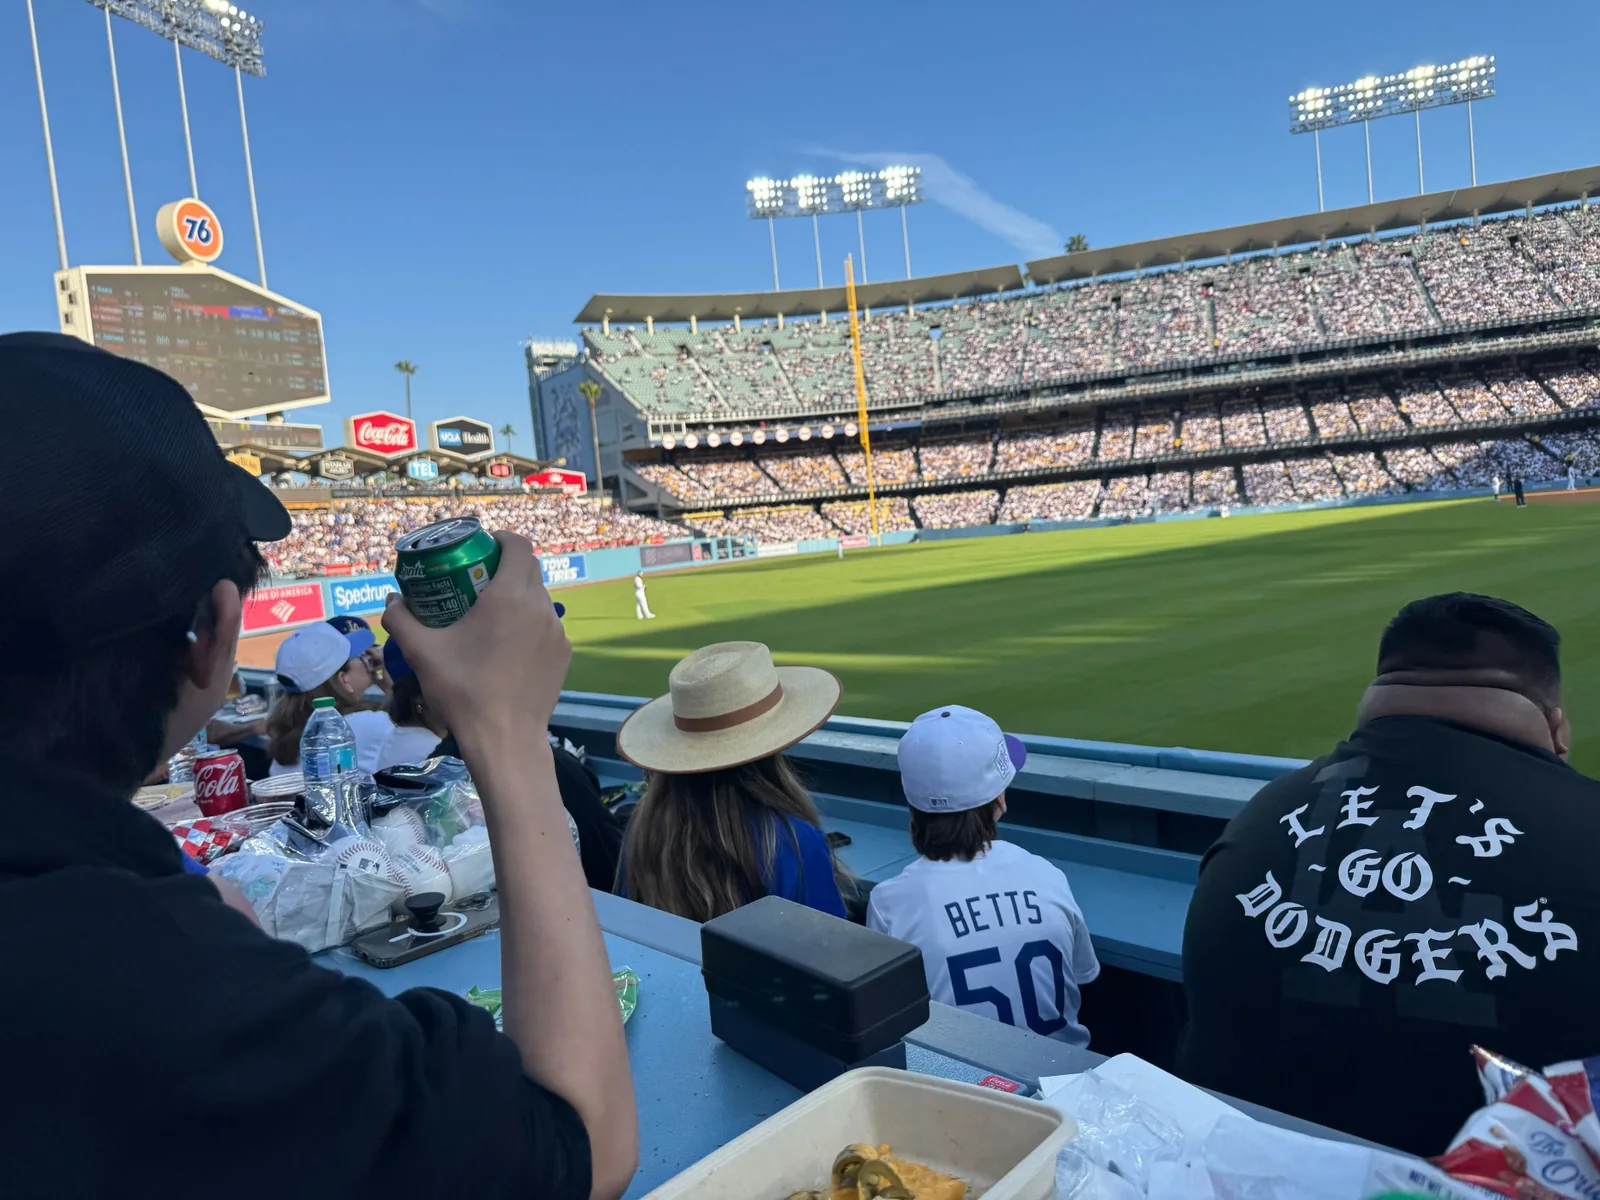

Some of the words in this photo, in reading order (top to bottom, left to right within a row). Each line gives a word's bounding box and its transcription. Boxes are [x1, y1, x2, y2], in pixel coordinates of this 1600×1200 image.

[184, 218, 212, 243] 76
[440, 432, 461, 442] UCLA
[462, 431, 490, 444] Health
[543, 557, 570, 572] TOYO
[549, 567, 578, 583] TIRES
[269, 590, 279, 600] OF
[280, 586, 314, 598] AMERICA
[335, 583, 394, 610] Spectrum
[432, 580, 451, 589] Facts
[440, 598, 458, 611] 140
[195, 760, 242, 798] Cola
[1279, 785, 1525, 858] LET'S
[944, 890, 1043, 939] BETTS
[1235, 870, 1579, 986] DODGERS
[946, 939, 1066, 1037] 50
[1530, 1131, 1567, 1158] The
[1409, 1168, 1426, 1187] NET
